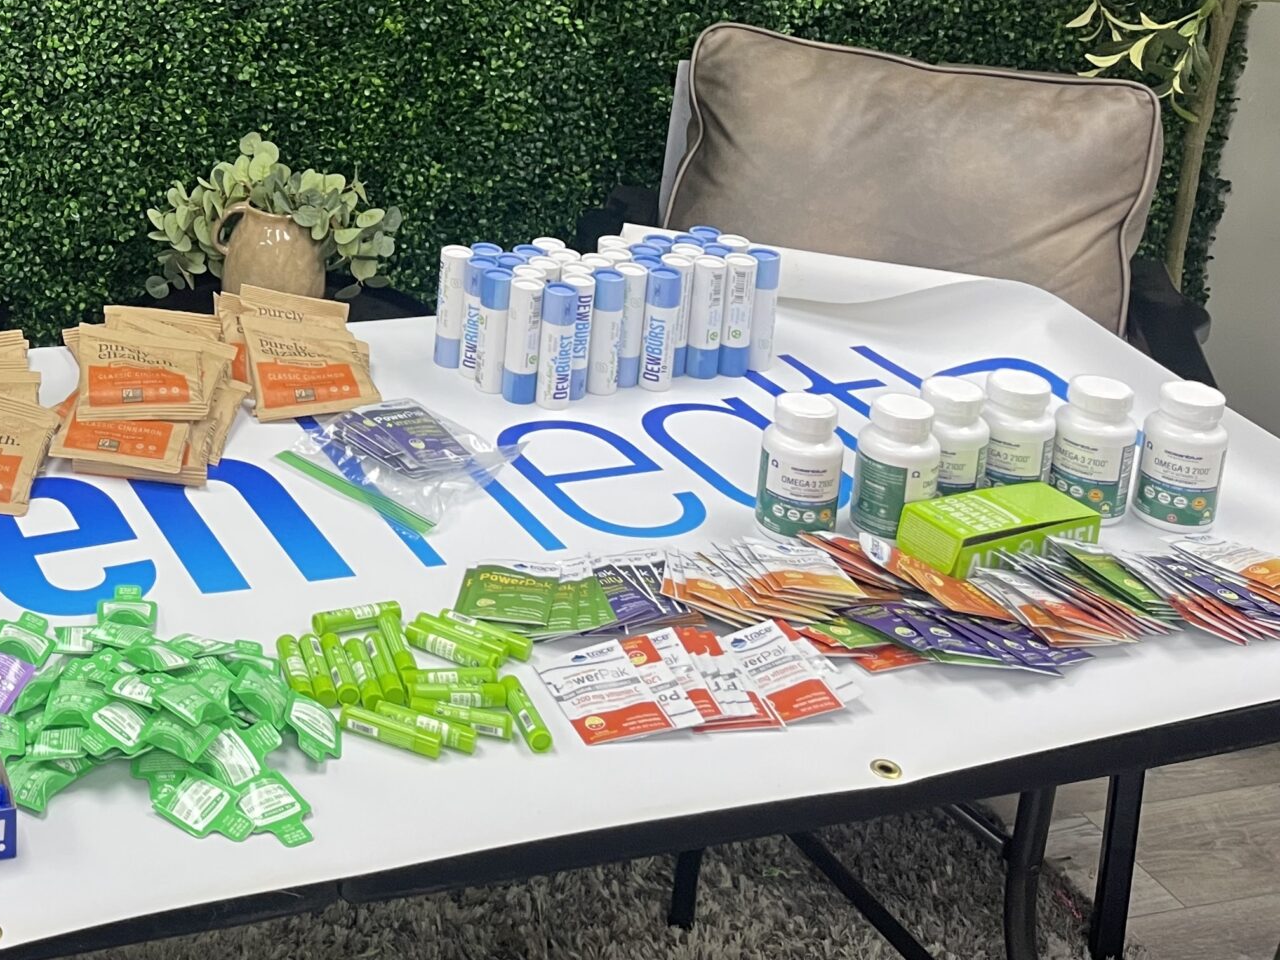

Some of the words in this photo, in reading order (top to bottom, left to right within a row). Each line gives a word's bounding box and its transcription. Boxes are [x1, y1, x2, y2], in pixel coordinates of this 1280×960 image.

[573, 294, 593, 360] DEWBURST
[553, 334, 573, 400] DEWBURST
[642, 316, 666, 383] DEWBURST
[479, 572, 553, 589] PowerPak
[586, 645, 615, 659] trace
[744, 626, 773, 643] trace
